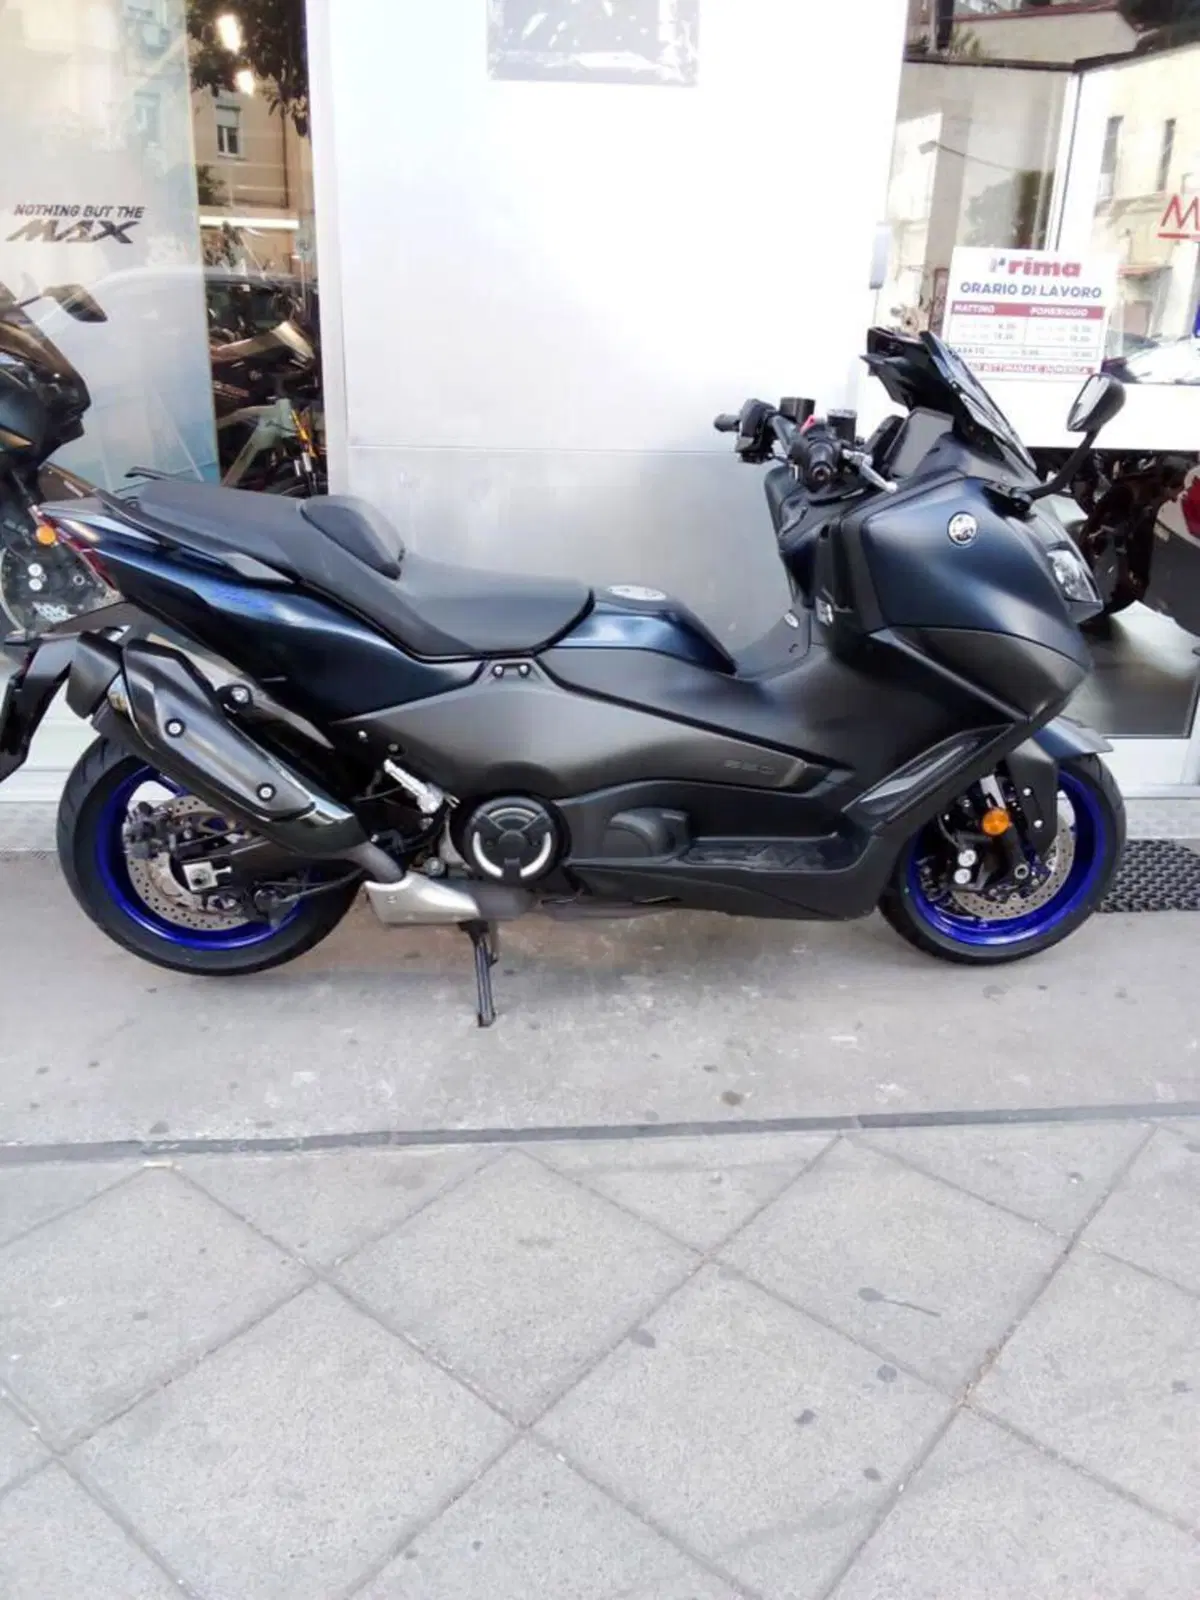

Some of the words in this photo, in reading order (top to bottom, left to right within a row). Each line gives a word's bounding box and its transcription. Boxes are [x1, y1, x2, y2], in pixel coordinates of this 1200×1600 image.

[14, 204, 81, 217] NOTHING
[83, 205, 114, 218] BUT
[115, 206, 145, 218] THE
[5, 219, 140, 244] MAX
[960, 281, 1018, 296] ORARIO
[1021, 284, 1037, 296] DI
[1039, 285, 1102, 299] LAVORO
[953, 304, 996, 314] MATTINO
